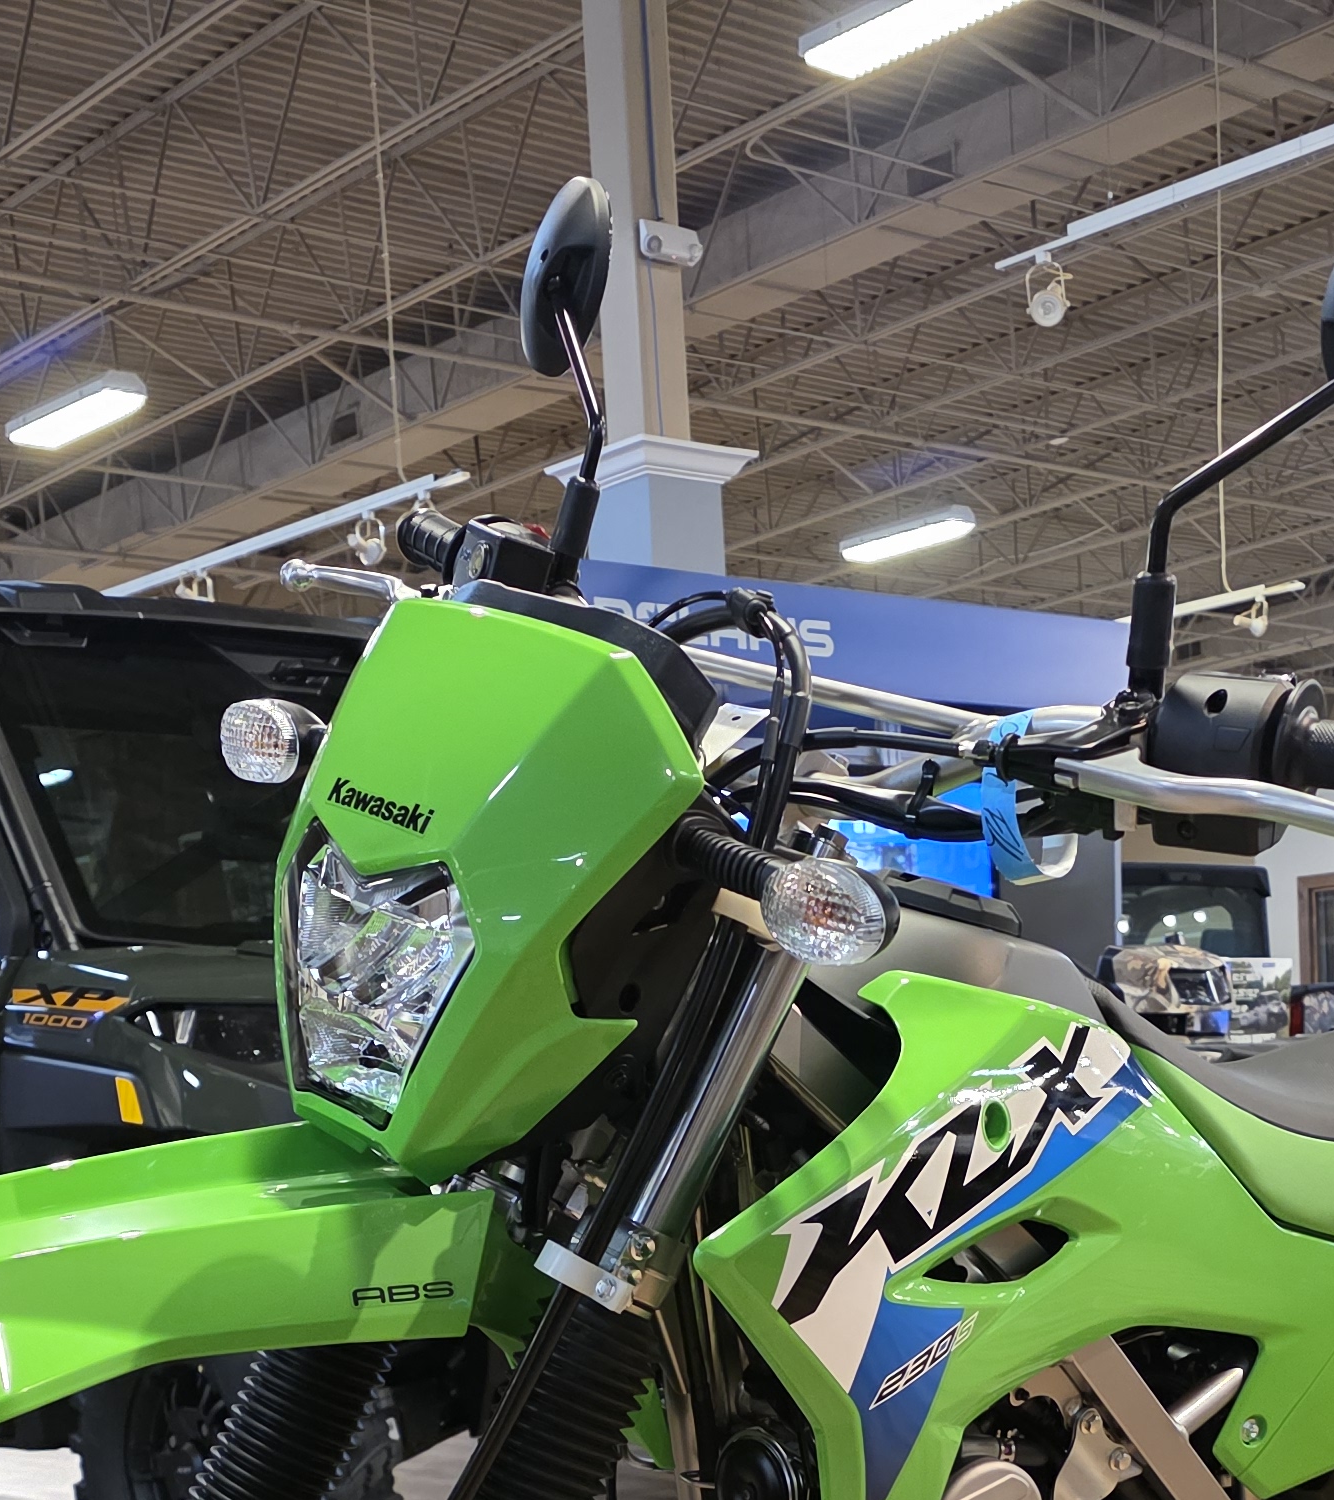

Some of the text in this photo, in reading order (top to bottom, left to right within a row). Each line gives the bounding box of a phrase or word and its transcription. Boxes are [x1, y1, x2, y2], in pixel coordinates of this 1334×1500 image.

[327, 777, 435, 835] Kawasaki
[15, 983, 115, 1007] XP
[22, 1012, 88, 1029] 1000
[776, 1025, 1105, 1327] KLX
[352, 1281, 454, 1307] ABS
